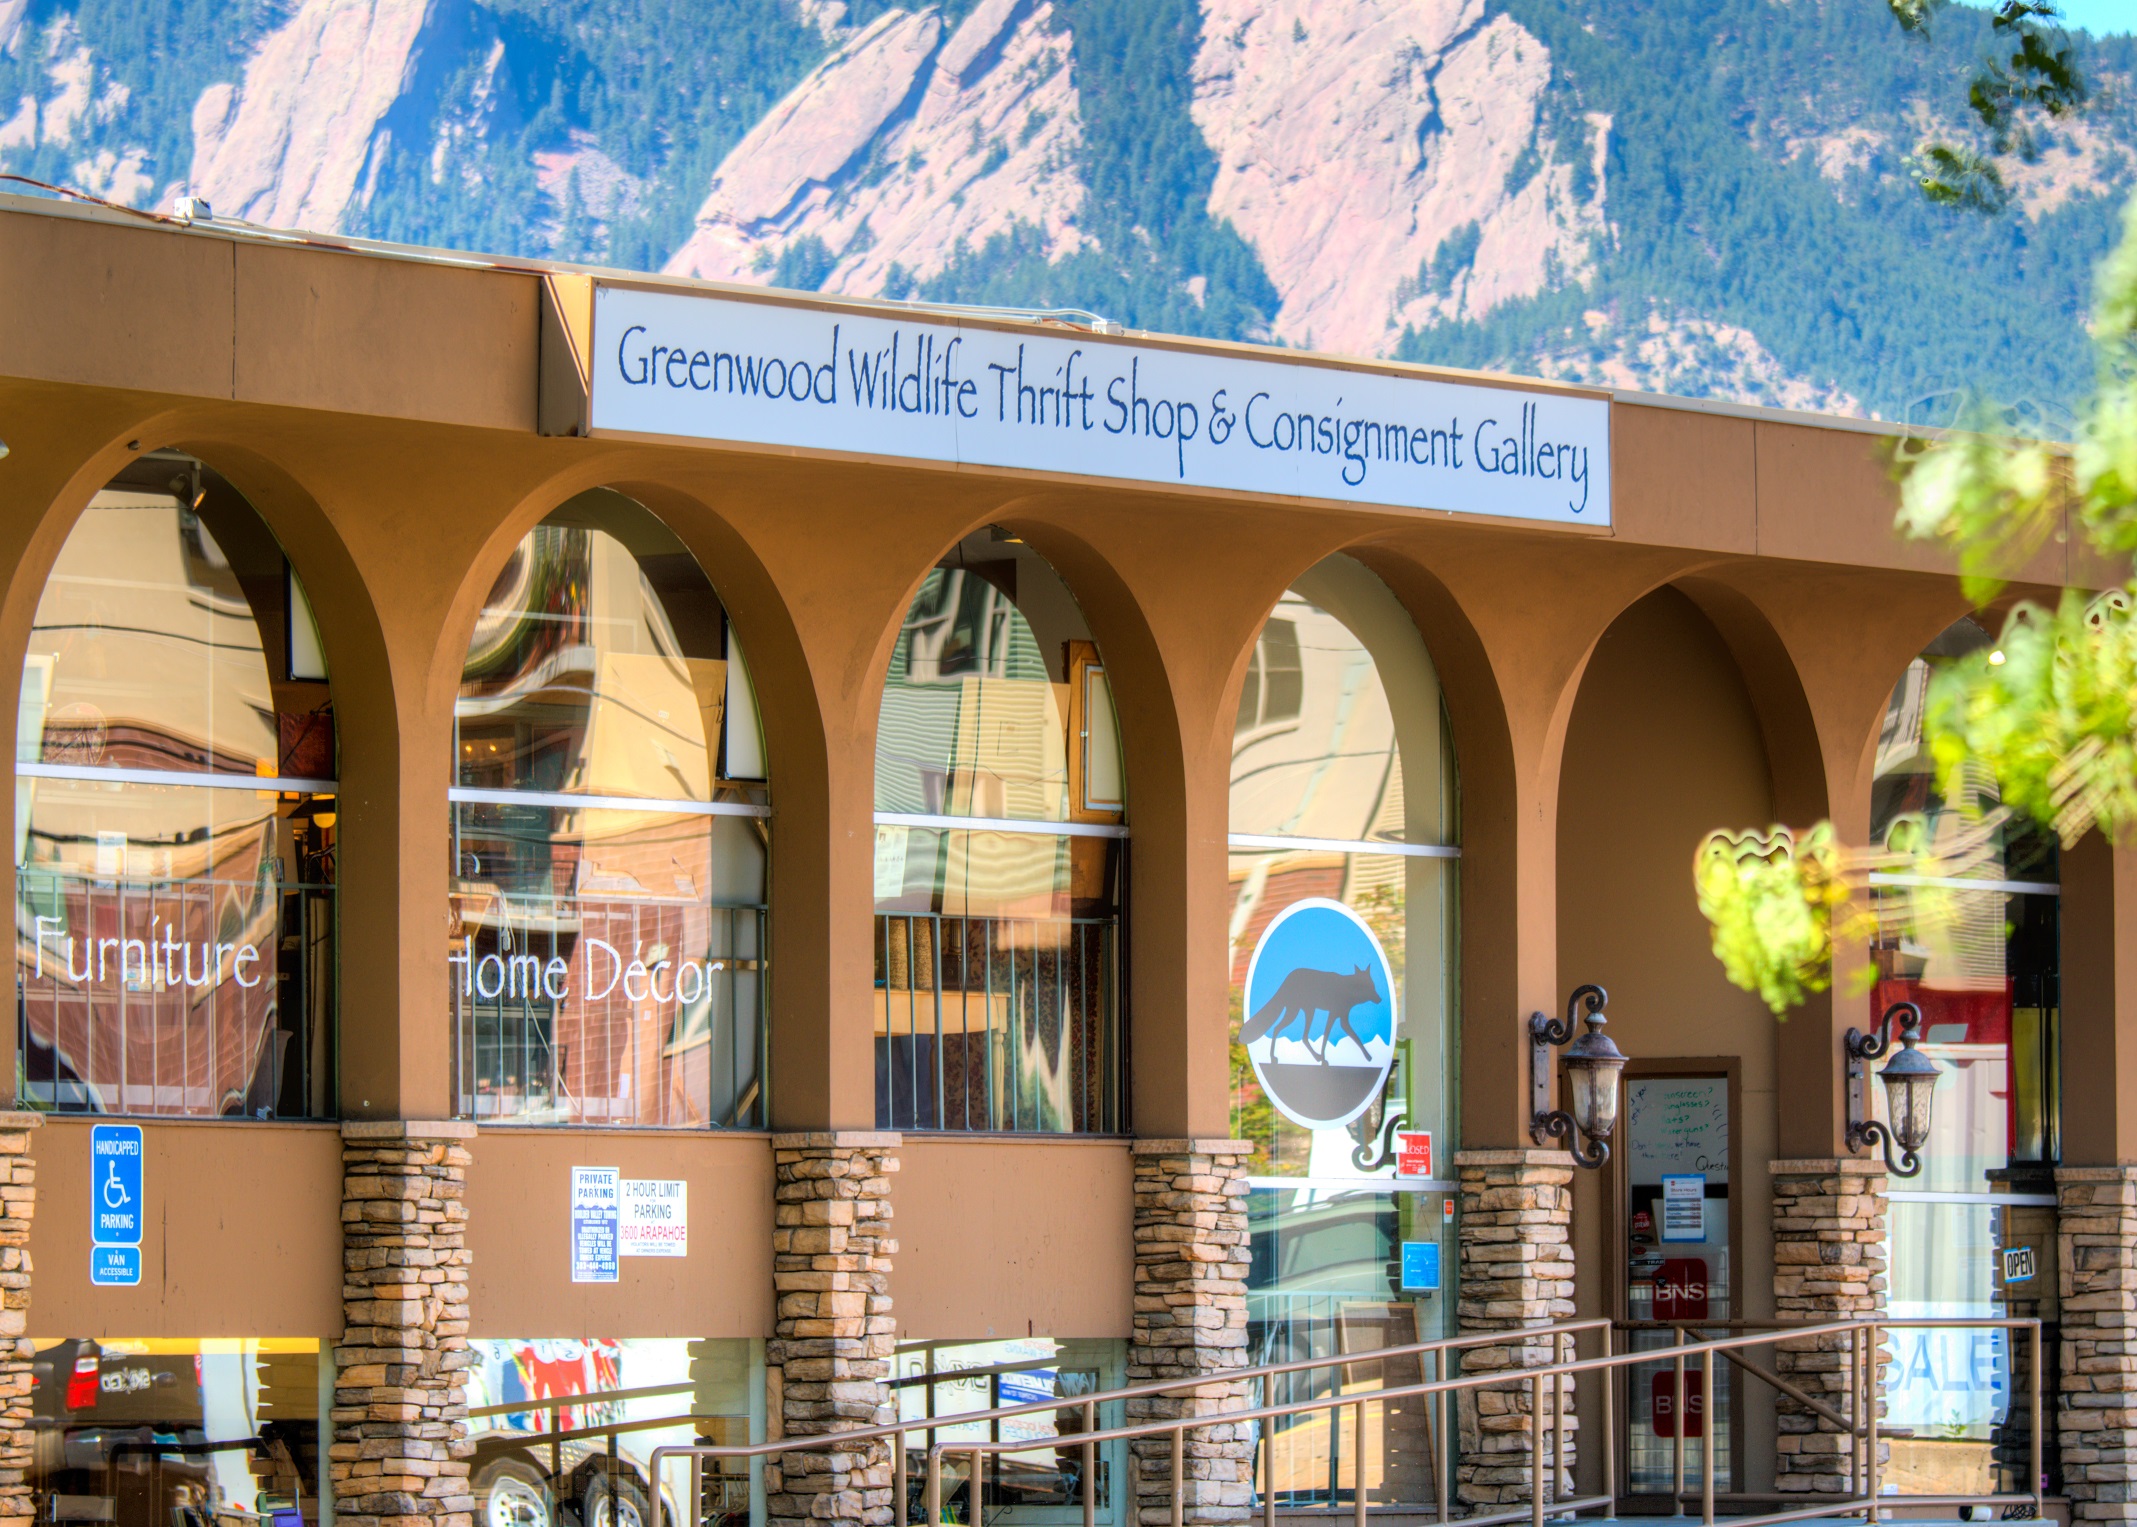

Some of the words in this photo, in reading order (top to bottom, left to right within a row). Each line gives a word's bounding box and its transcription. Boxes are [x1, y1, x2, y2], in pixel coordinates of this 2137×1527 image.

[618, 323, 840, 404] Greenwood
[848, 329, 978, 418] Wildlife
[987, 343, 1095, 431] Thrift
[1103, 356, 1199, 479] Shop
[1208, 388, 1237, 446] &
[1245, 391, 1464, 486] Consignment
[1473, 400, 1589, 514] Gallery
[34, 915, 261, 988] Furniture
[447, 934, 570, 1000] Home
[584, 937, 725, 1005] Décor
[96, 1140, 139, 1156] HANDICAPPED
[1402, 1144, 1430, 1156] LOSED
[579, 1174, 613, 1185] PRIVATE
[578, 1188, 614, 1199] PARKING
[626, 1182, 632, 1197] 2
[633, 1182, 657, 1198] HOUR
[659, 1183, 680, 1198] LIMIT
[634, 1204, 672, 1219] PARKING
[100, 1213, 134, 1229] PARKING
[620, 1225, 638, 1240] 3600
[639, 1226, 686, 1241] ARAPAHOE
[107, 1254, 126, 1266] VAN
[2006, 1250, 2033, 1278] OPEN
[99, 1267, 133, 1276] ACCESSIBLE
[1655, 1282, 1706, 1301] BNS
[1884, 1333, 2003, 1392] SALE
